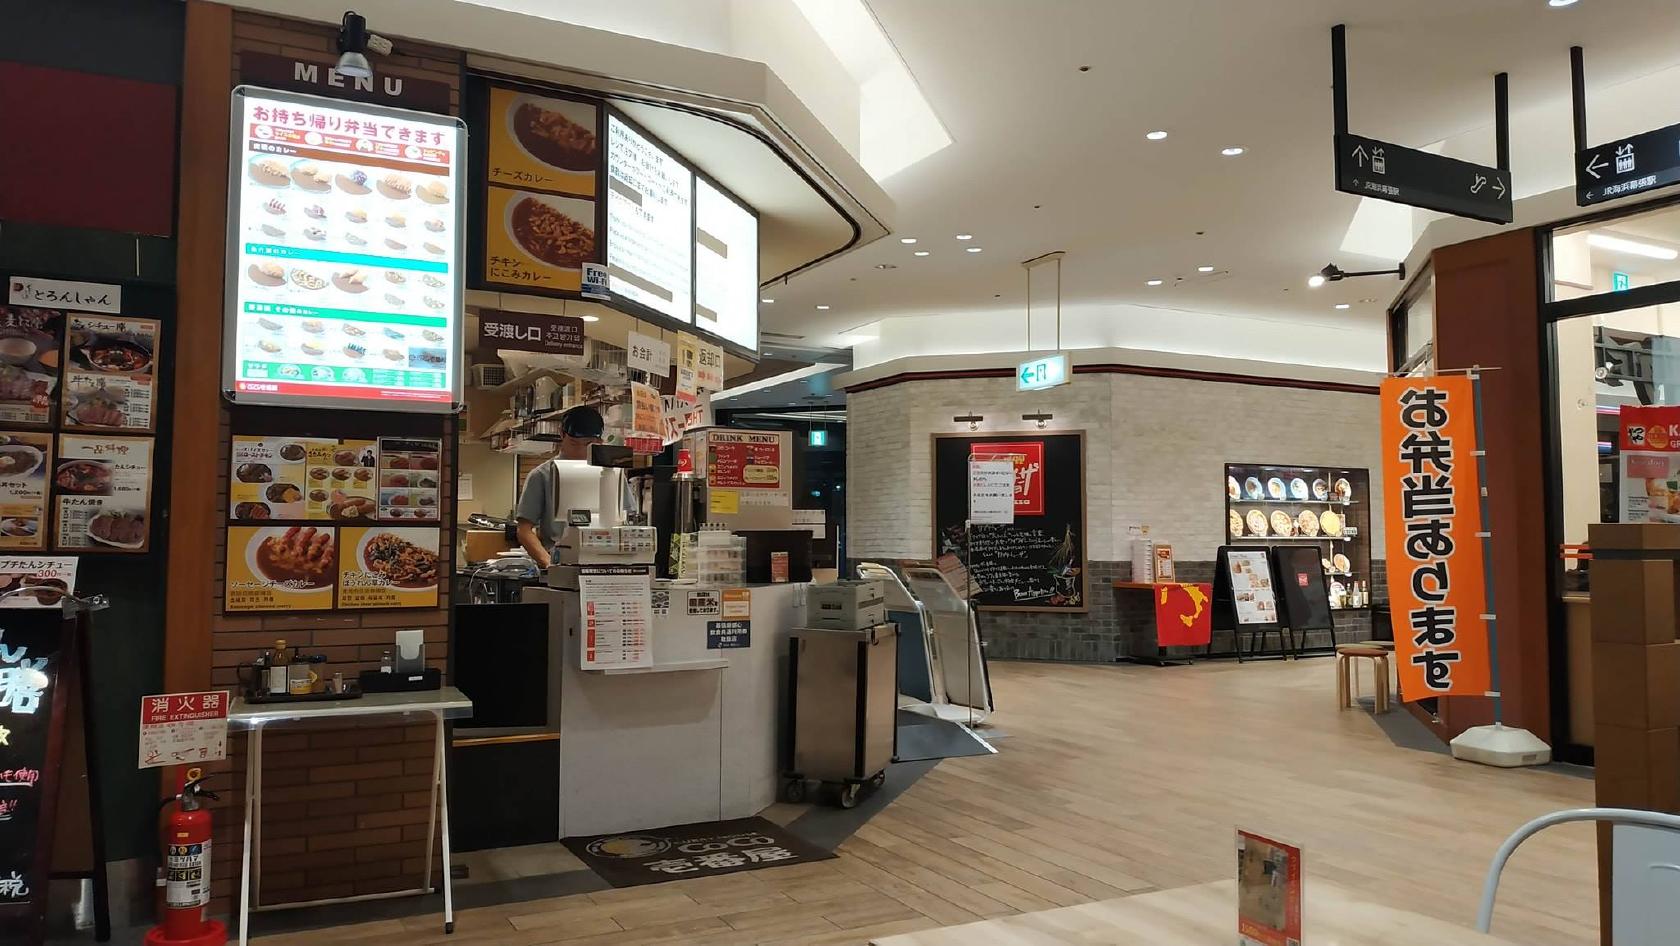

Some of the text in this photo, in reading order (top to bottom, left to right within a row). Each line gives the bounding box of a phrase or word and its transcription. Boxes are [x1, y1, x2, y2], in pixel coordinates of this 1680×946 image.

[294, 62, 402, 96] MENU
[492, 167, 553, 183] チーズカレー
[1602, 175, 1657, 196] JR海浜幕張駅
[490, 256, 521, 267] チキン
[490, 267, 552, 279] にこみカレー
[34, 289, 112, 306] とろんしゃん
[484, 322, 541, 341] 受渡し口
[151, 694, 219, 713] 消火器
[170, 710, 219, 720] EXTINGUISHER
